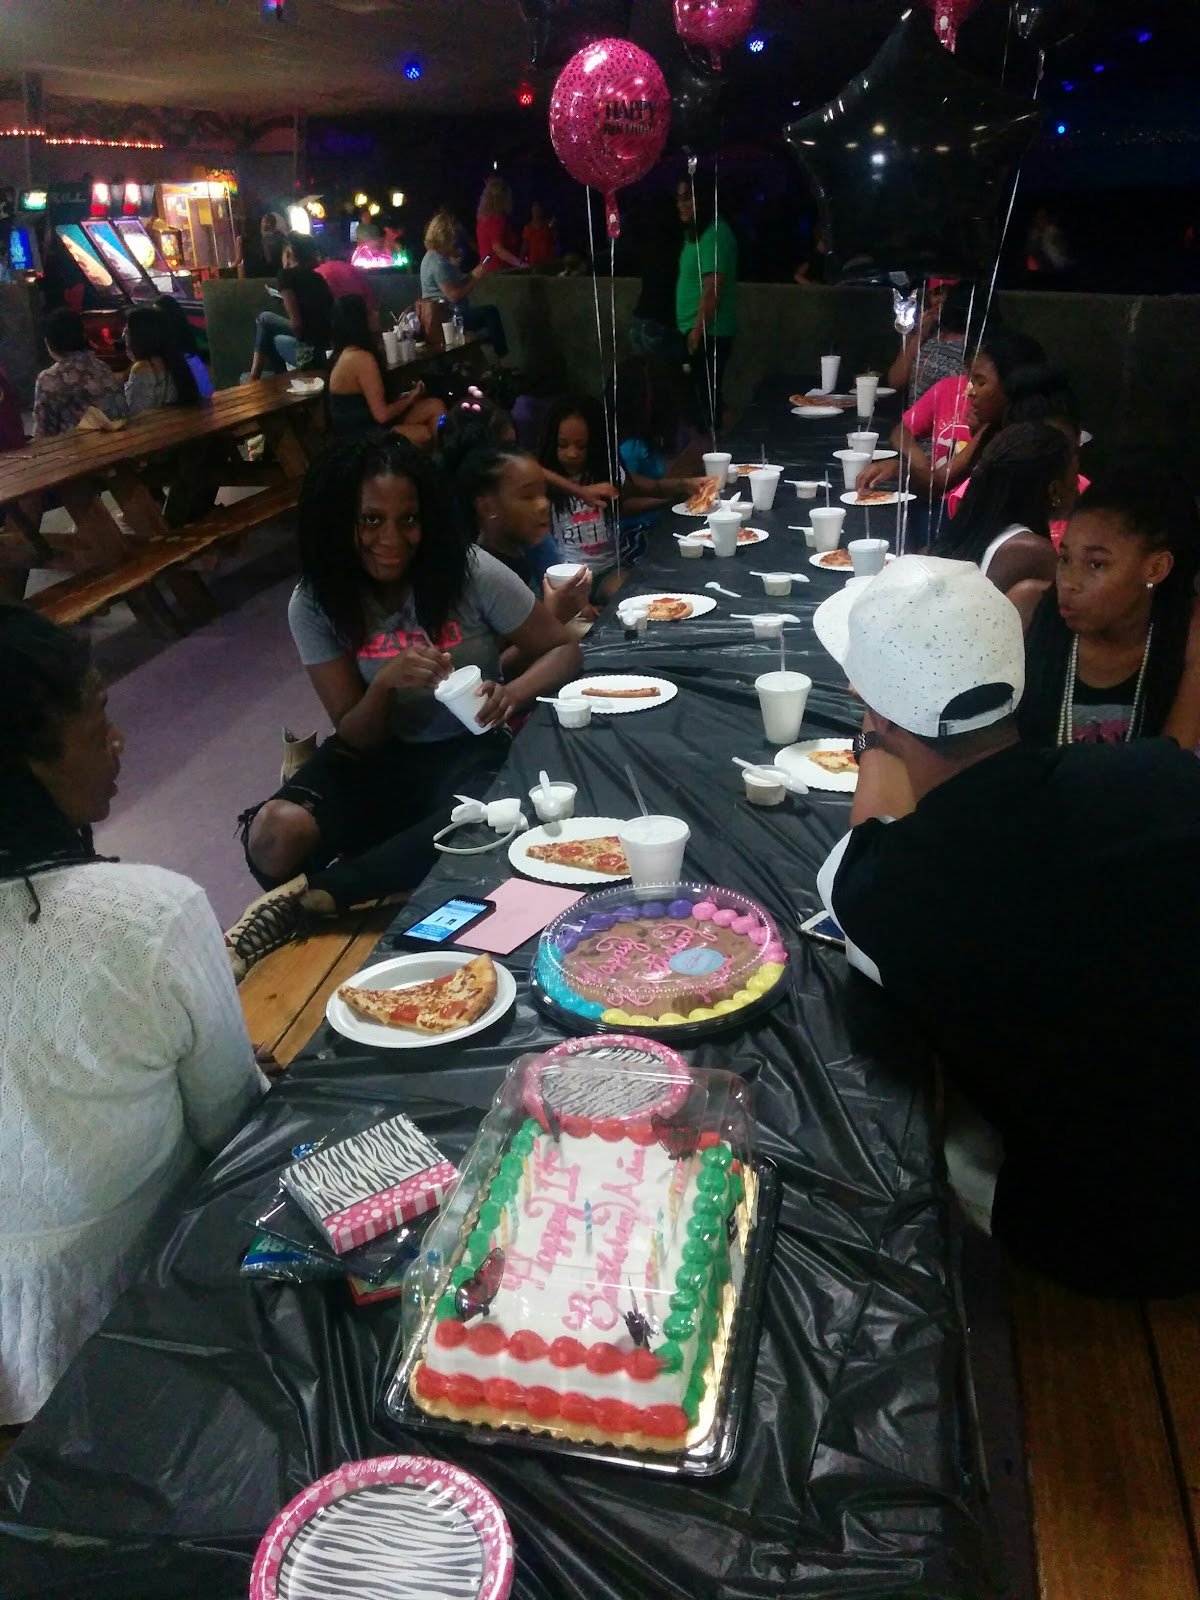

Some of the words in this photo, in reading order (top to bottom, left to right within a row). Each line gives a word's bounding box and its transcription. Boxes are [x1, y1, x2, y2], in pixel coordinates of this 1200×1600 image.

[605, 100, 654, 120] HAPPY
[501, 1196, 588, 1291] Happy
[562, 1201, 651, 1331] Birthday
